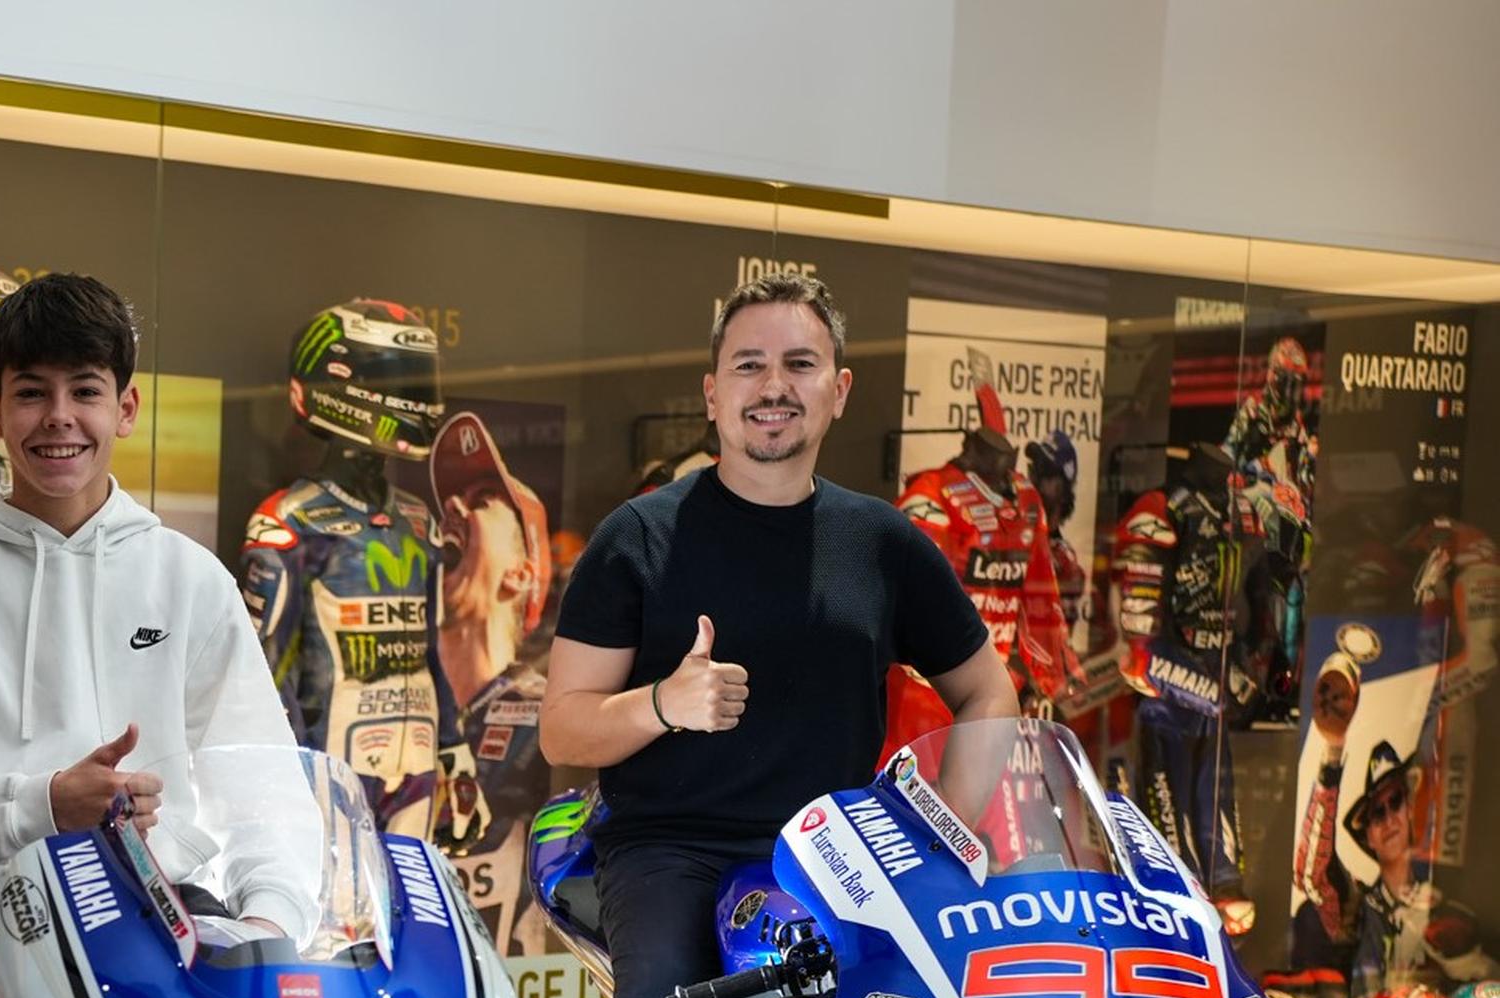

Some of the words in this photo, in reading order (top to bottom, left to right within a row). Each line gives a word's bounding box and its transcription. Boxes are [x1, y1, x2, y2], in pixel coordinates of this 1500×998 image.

[1413, 320, 1469, 357] FABIO
[1340, 353, 1466, 393] QUARTARARO
[1006, 405, 1102, 443] ORTUGAL
[135, 626, 163, 643] NIKE
[1148, 654, 1219, 703] YAMAHA
[844, 797, 925, 879] YAMAHA
[56, 838, 123, 933] YAMAHA
[387, 842, 449, 928] YAMAHA
[810, 826, 850, 882] Eurasian
[840, 870, 876, 910] Bank
[937, 889, 1196, 941] movistar
[281, 986, 319, 998] ENEOS
